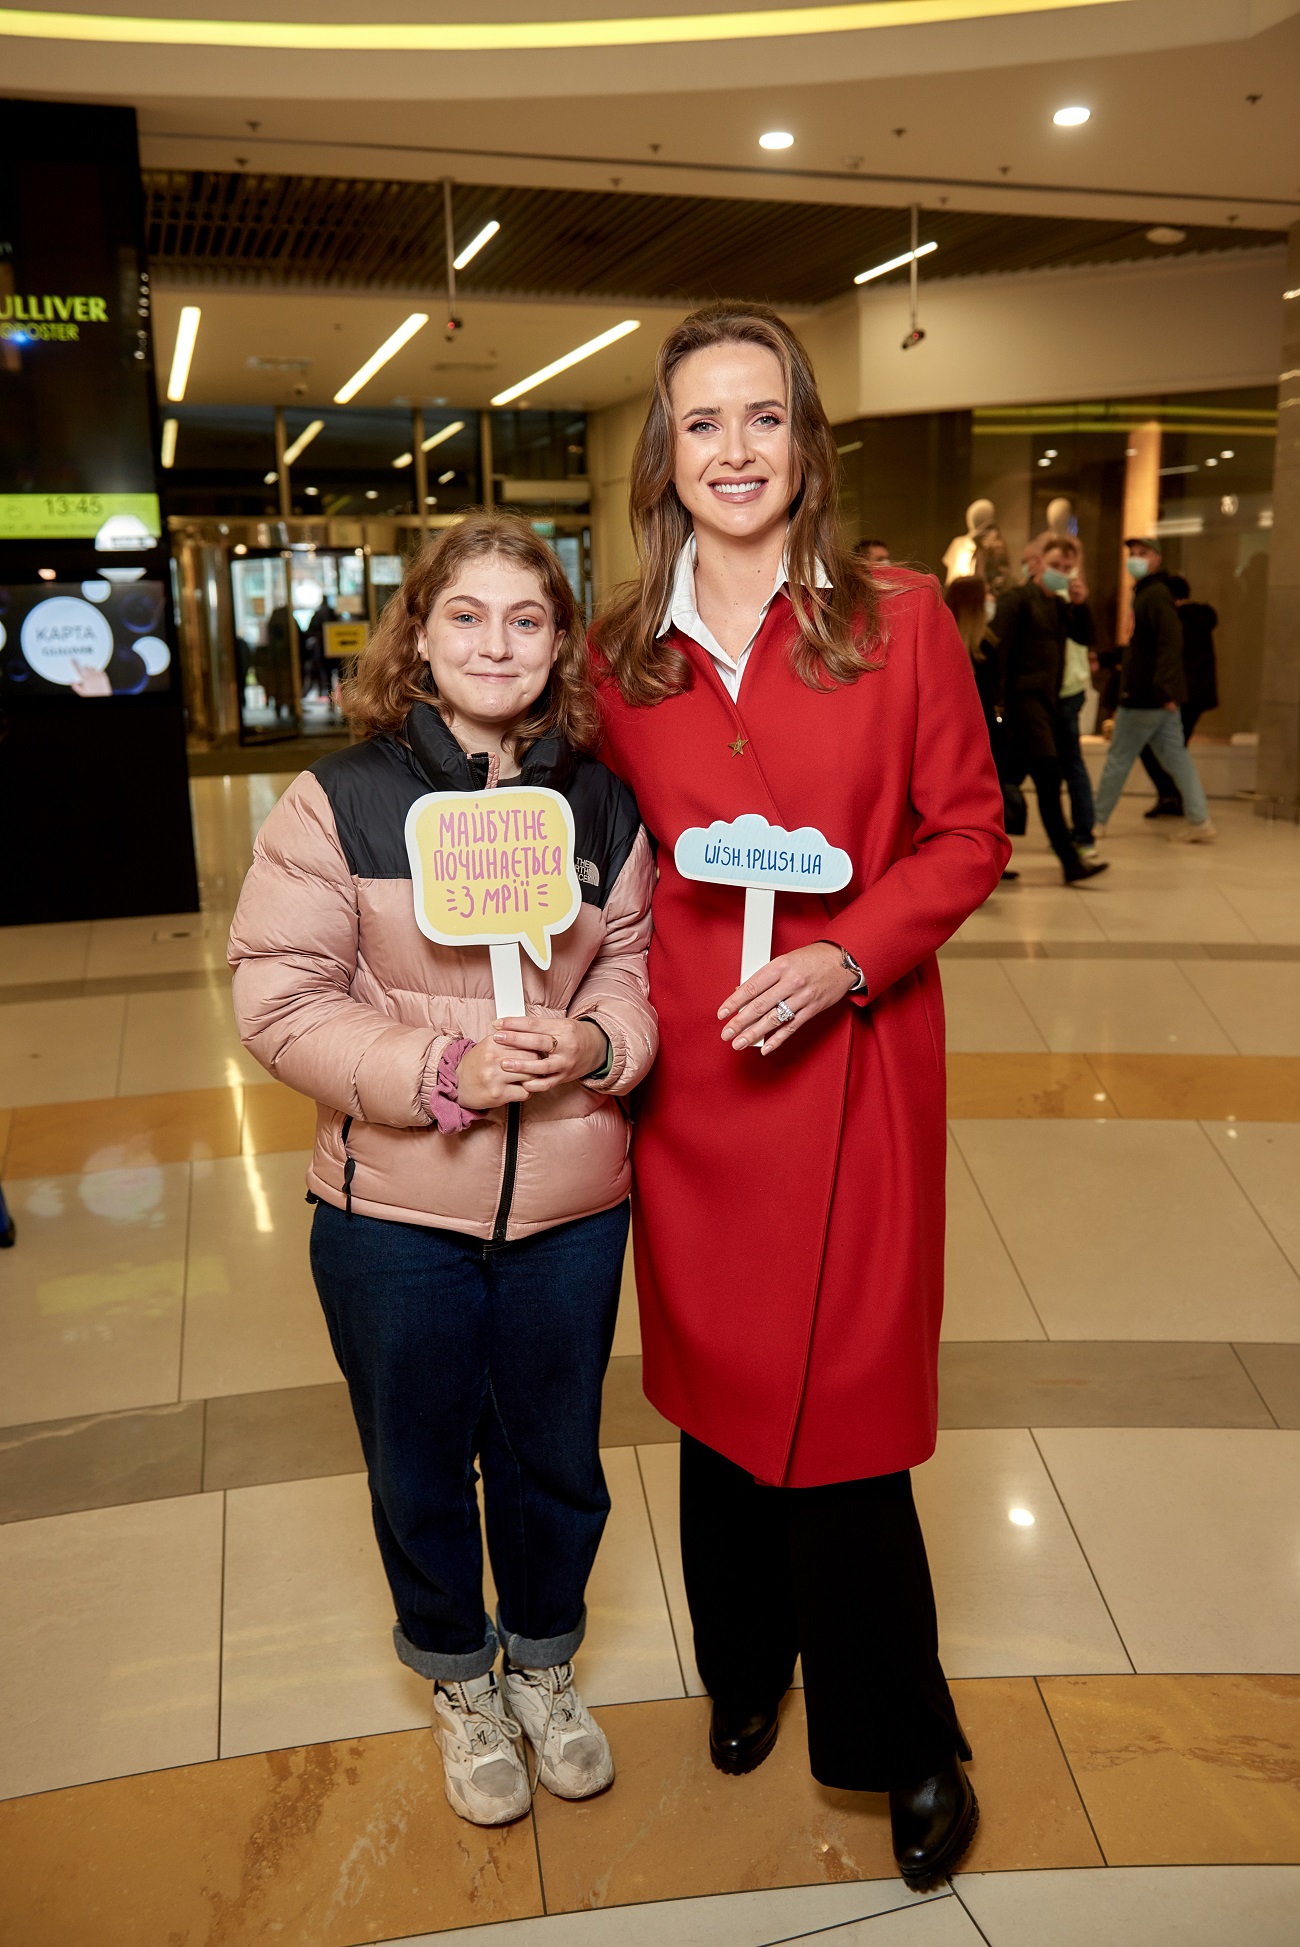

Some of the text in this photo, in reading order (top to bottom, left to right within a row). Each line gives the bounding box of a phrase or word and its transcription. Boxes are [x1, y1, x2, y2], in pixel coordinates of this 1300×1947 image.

[44, 495, 103, 517] 13:45
[439, 803, 548, 848] МАЙБУТНЄ
[433, 845, 562, 881] ПОЧИНАЄТЬСЯ
[576, 857, 590, 868] THE
[482, 879, 530, 915] МРІЇ
